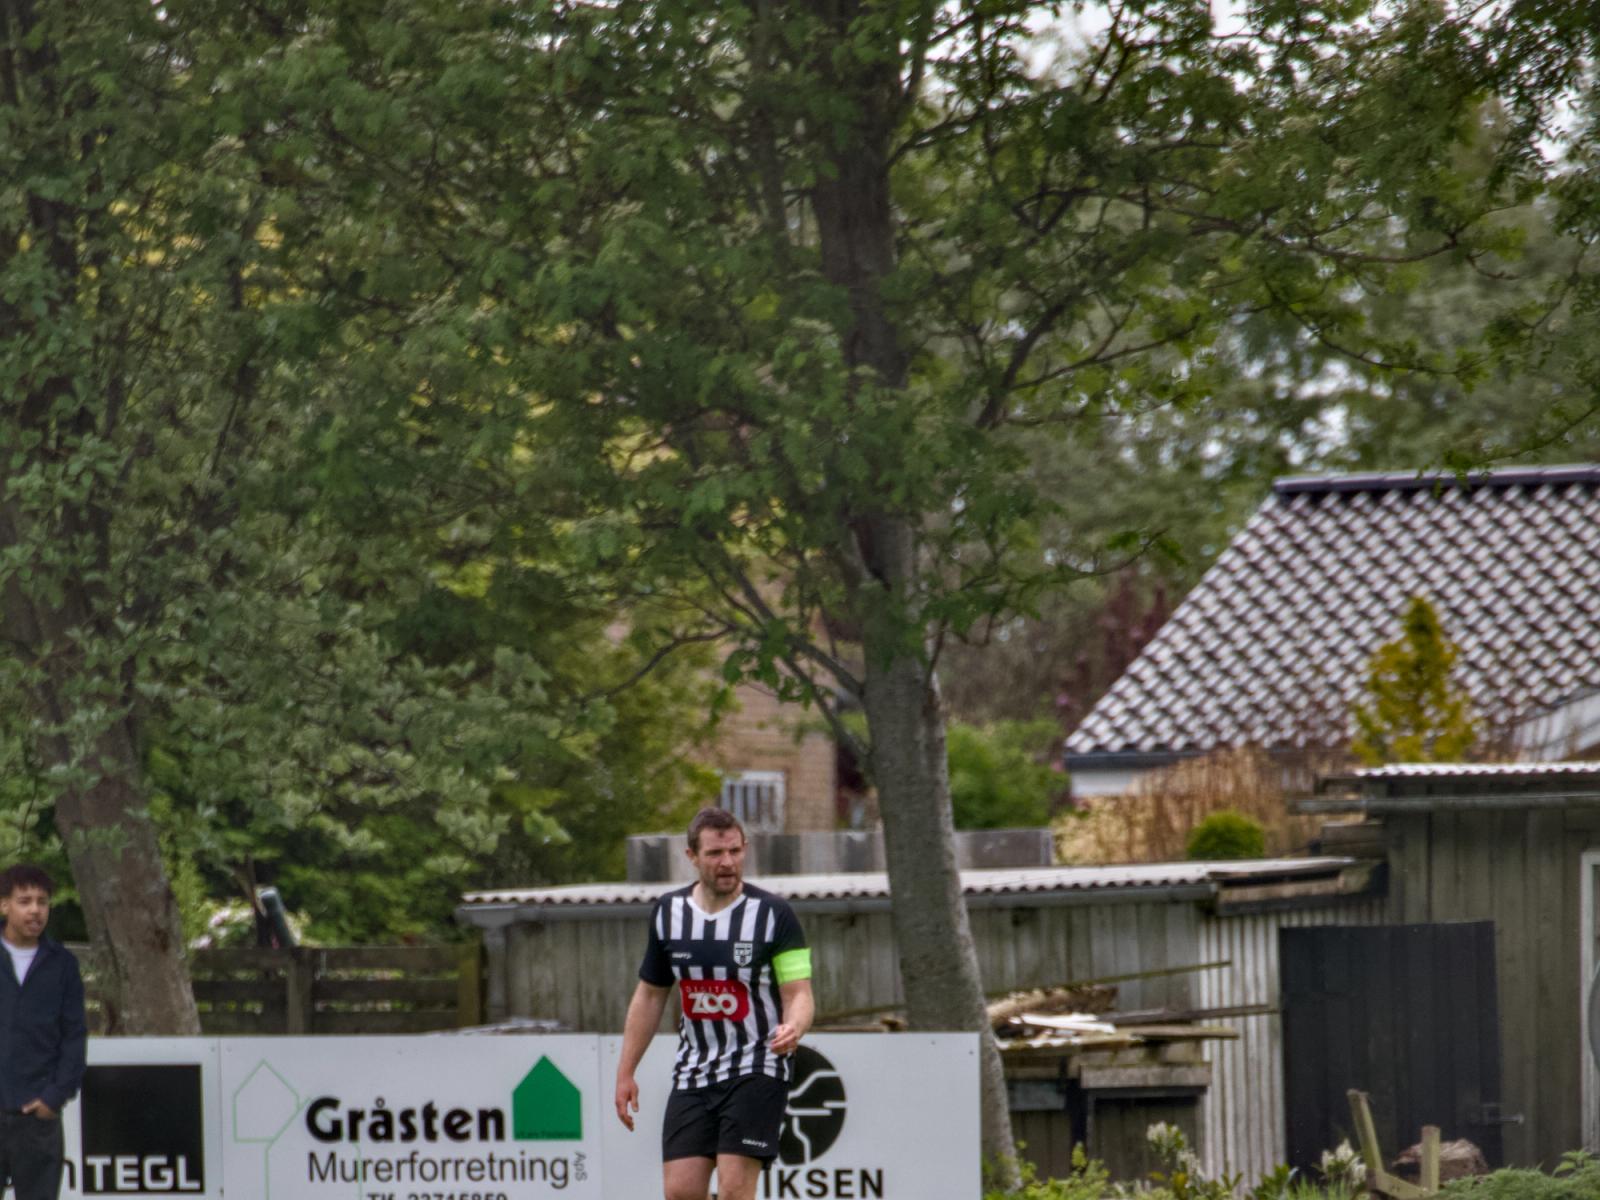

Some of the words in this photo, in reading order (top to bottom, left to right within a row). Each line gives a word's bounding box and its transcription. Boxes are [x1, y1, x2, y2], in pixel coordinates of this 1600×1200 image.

[685, 985, 736, 993] DIGITAL
[688, 992, 738, 1015] ZOO
[306, 1097, 505, 1143] Gråsten
[308, 1151, 569, 1190] Murerforretning
[573, 1151, 588, 1181] ApS
[763, 1169, 883, 1199] IKSEN
